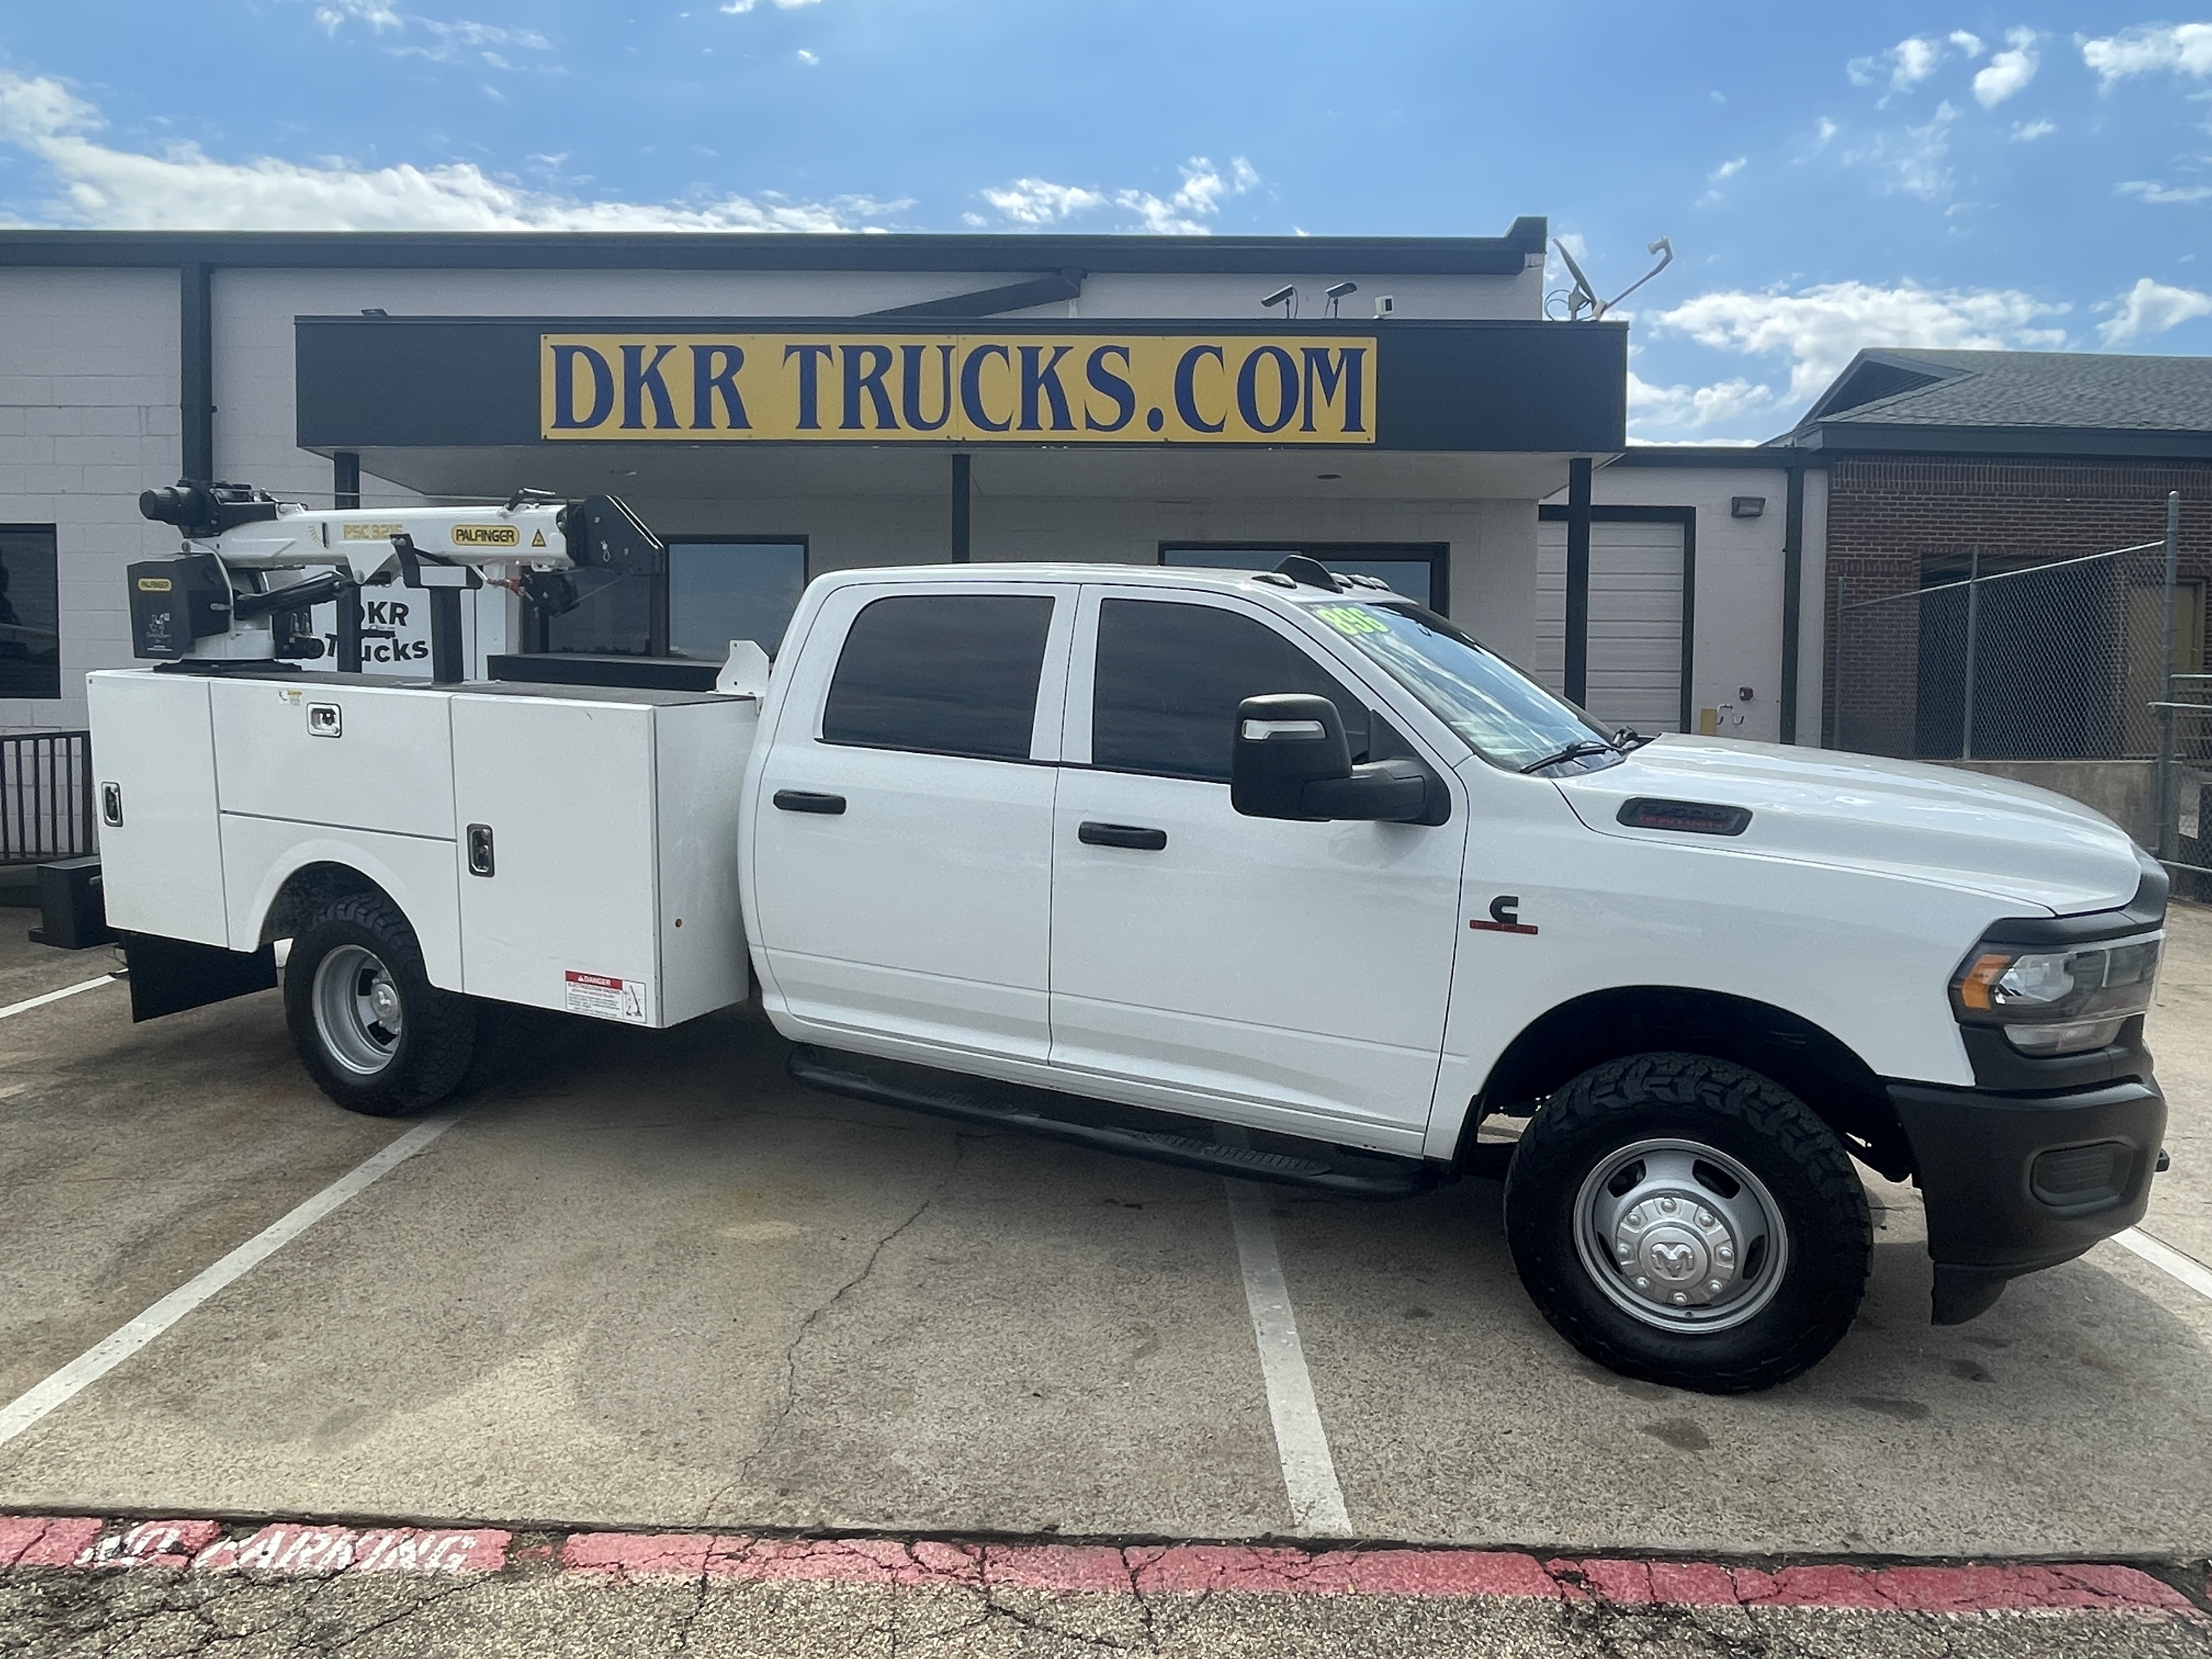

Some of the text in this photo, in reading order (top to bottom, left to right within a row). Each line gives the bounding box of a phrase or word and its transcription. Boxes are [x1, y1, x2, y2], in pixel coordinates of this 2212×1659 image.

[550, 344, 1368, 433] DKR TRUCKS.COM
[343, 524, 369, 539] PSC
[456, 529, 515, 542] PALFINGER
[360, 601, 410, 627] KR
